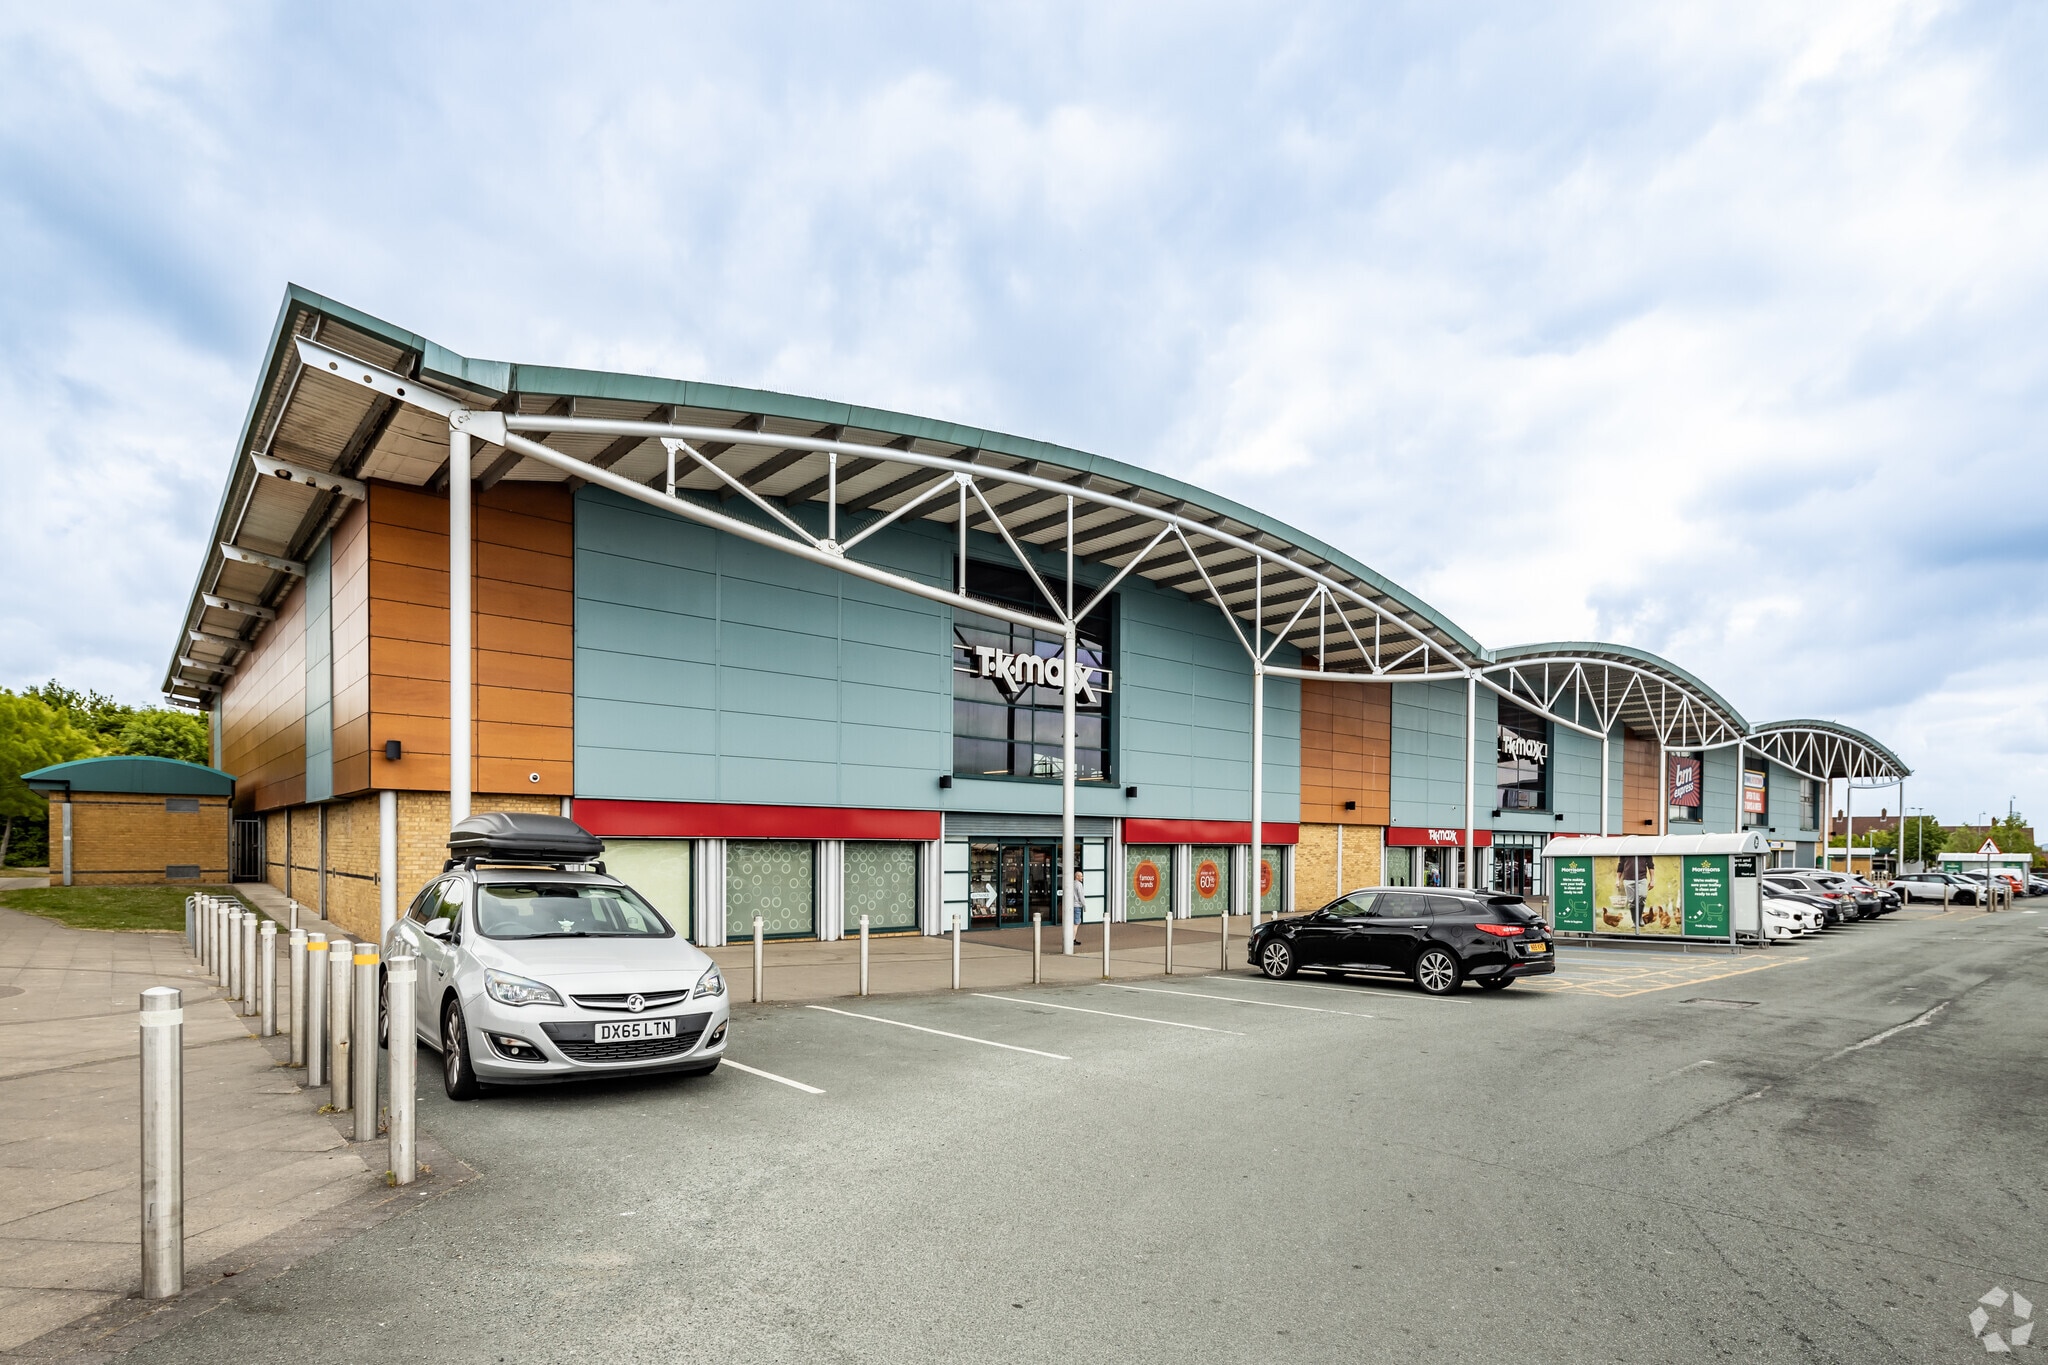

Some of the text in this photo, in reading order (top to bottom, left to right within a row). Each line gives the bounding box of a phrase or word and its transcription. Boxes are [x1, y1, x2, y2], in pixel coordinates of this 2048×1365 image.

[1674, 782, 1694, 798] express
[601, 1021, 670, 1040] DX65 LTN
